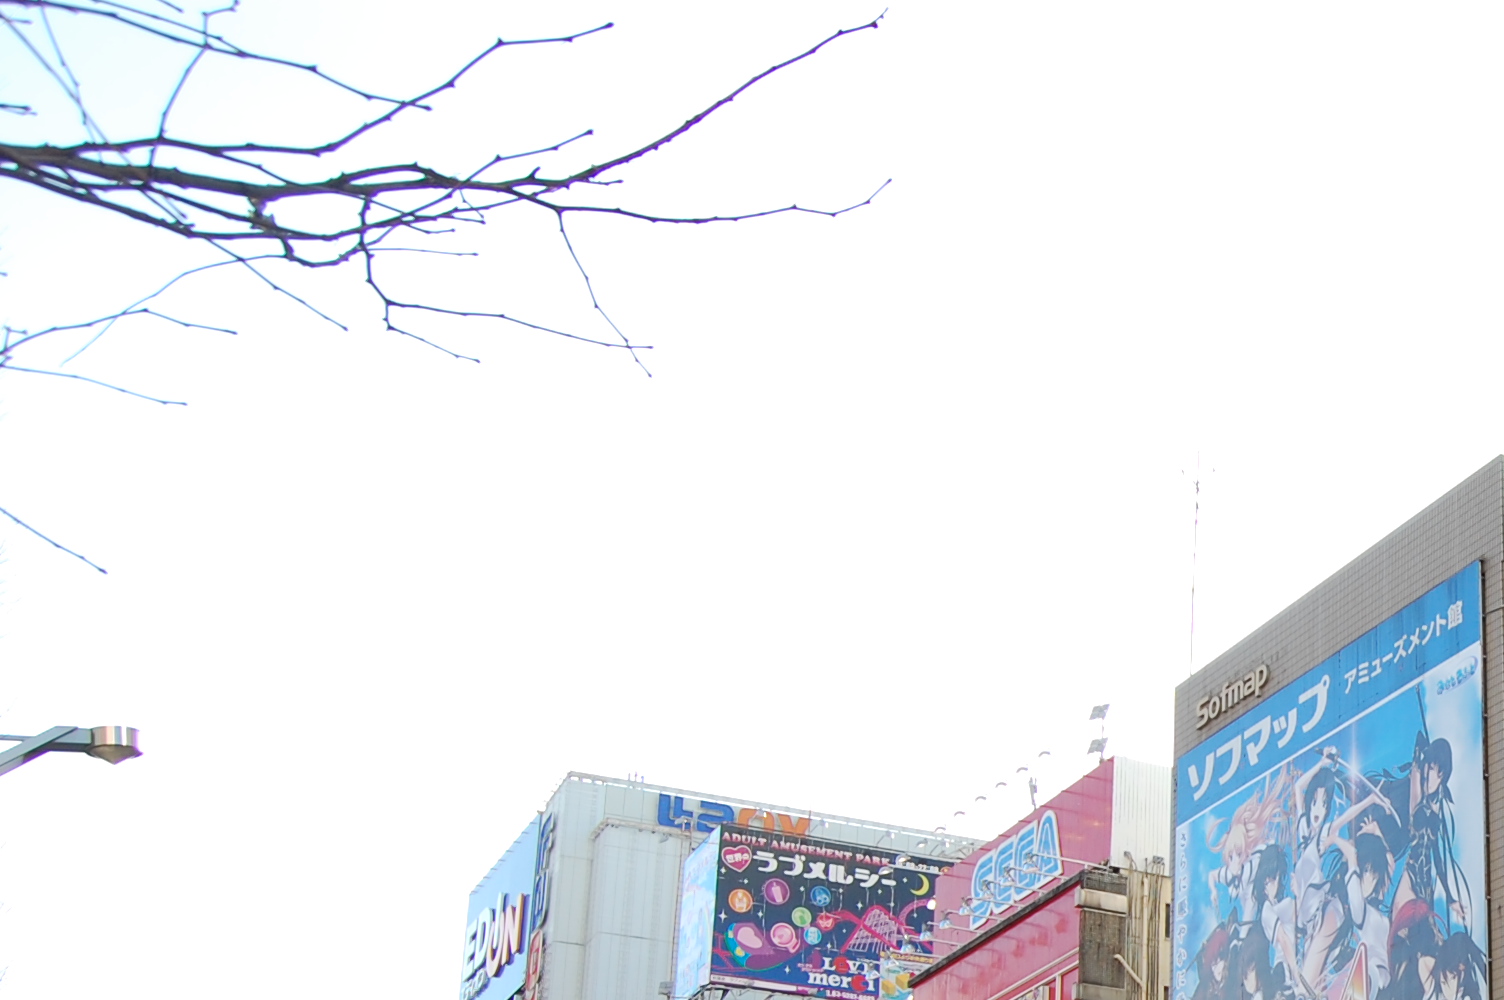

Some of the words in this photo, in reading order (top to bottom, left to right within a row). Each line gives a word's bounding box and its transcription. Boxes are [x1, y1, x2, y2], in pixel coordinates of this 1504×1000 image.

[1344, 600, 1463, 694] アミューズメント館
[1196, 663, 1270, 731] Sofmap
[1187, 674, 1331, 801] ソフマップ
[722, 832, 767, 847] ADULT
[771, 839, 853, 859] AMUSEMENT
[856, 853, 890, 865] PARK
[753, 850, 897, 888] ラブメルシー
[970, 811, 1063, 930] SEGA
[808, 971, 876, 993] merci
